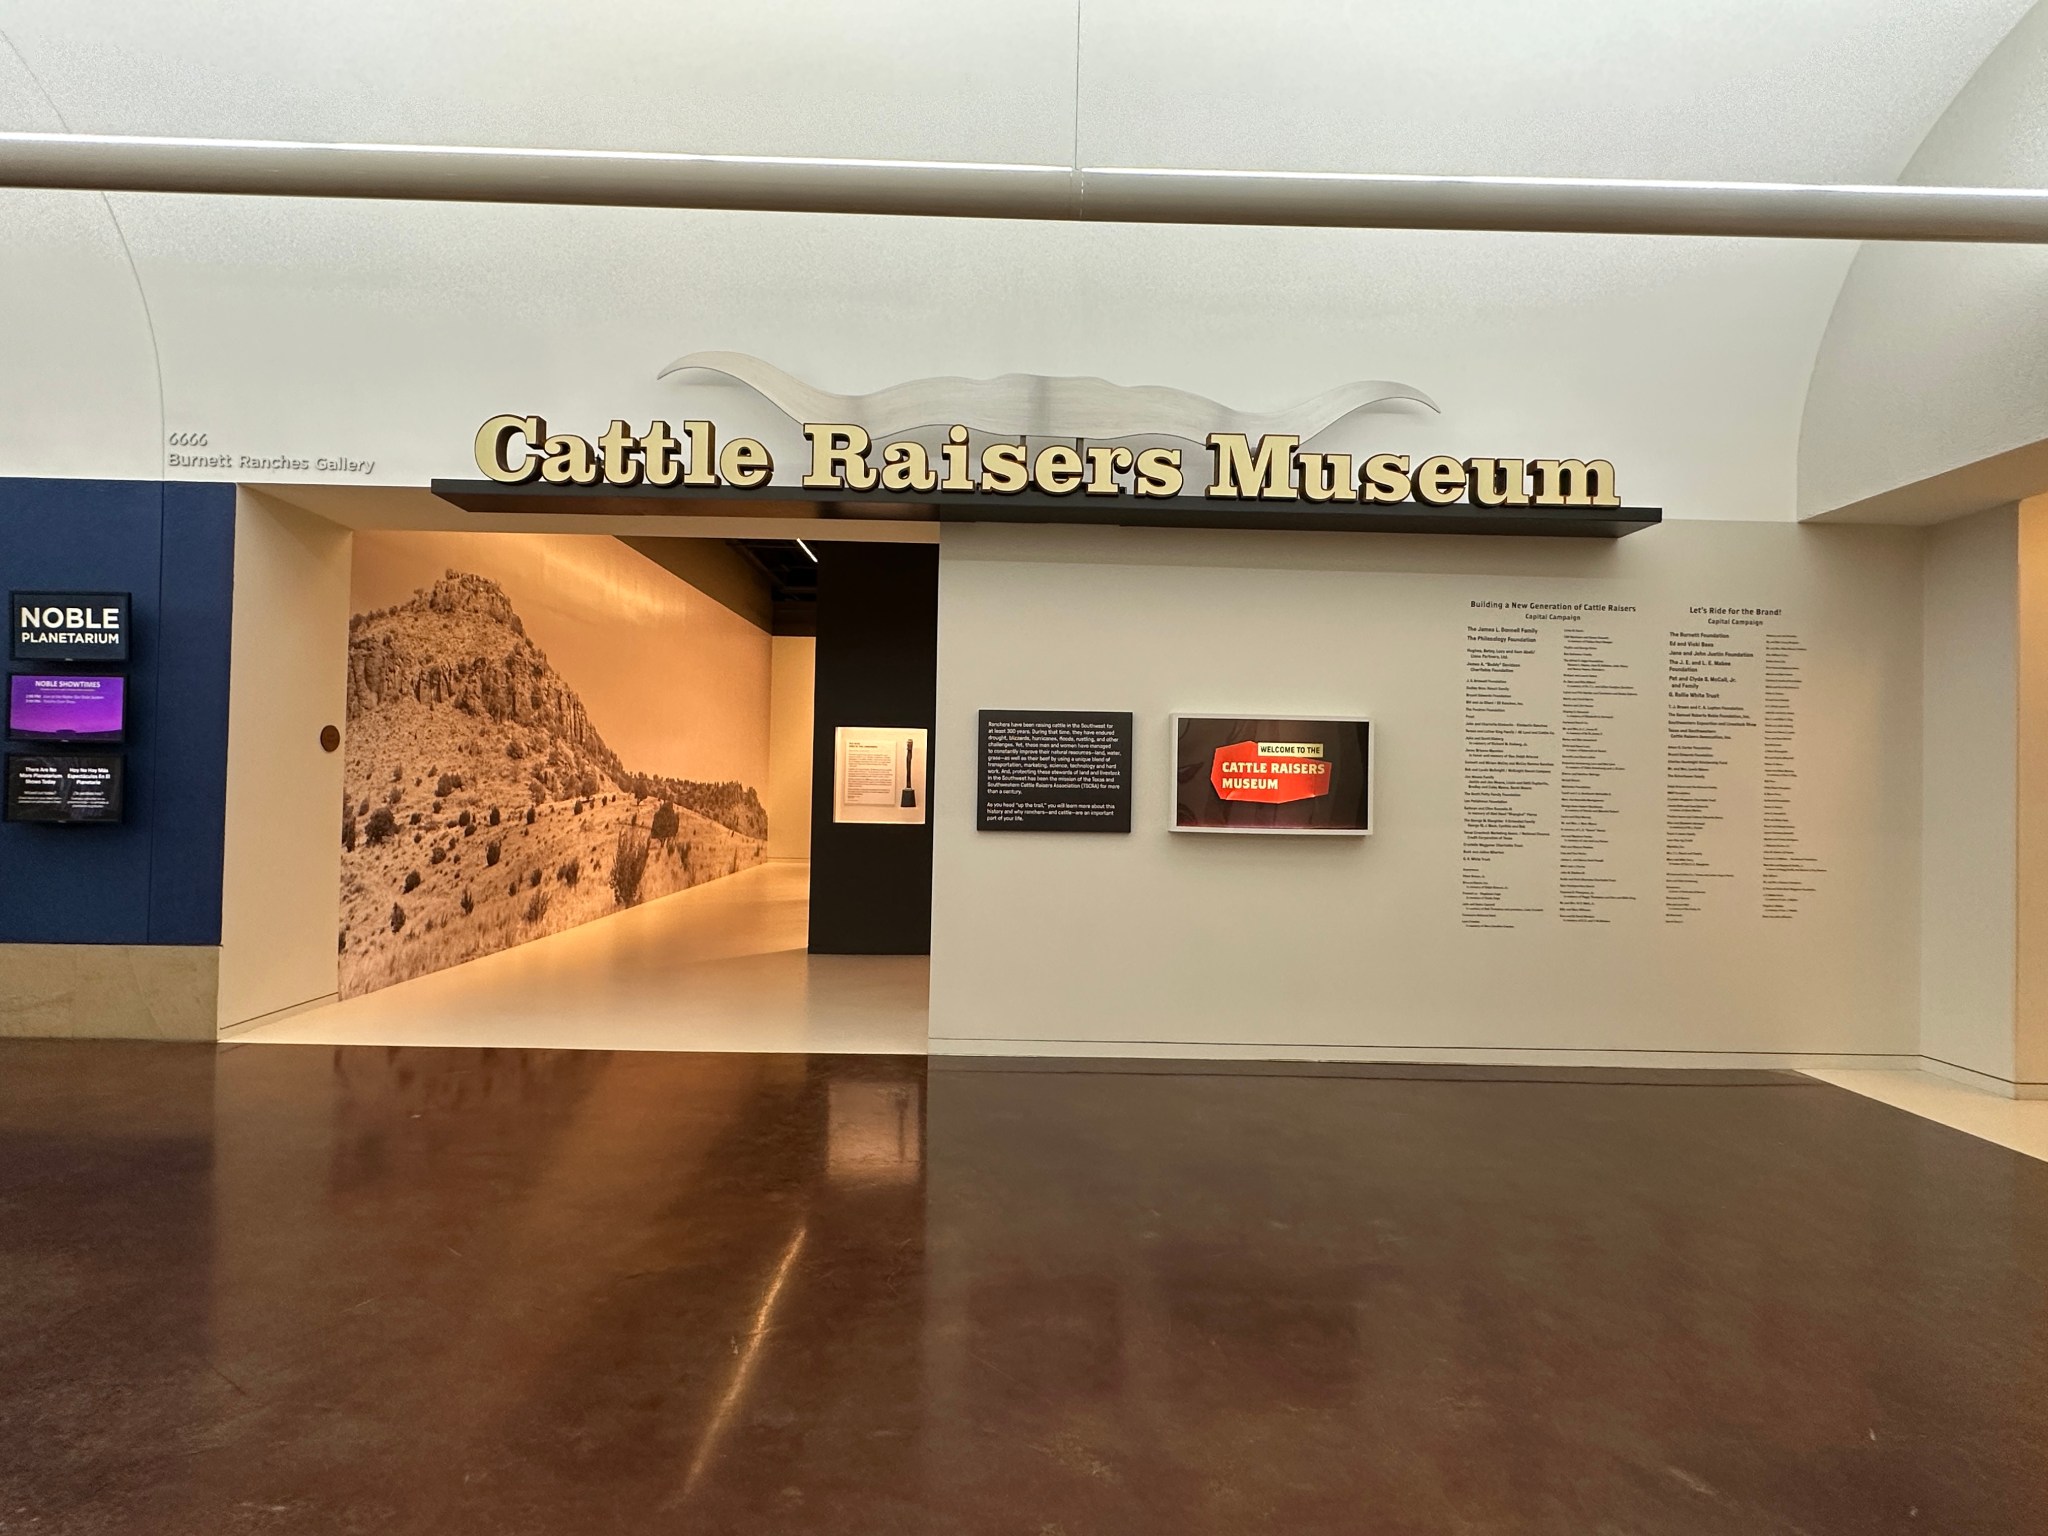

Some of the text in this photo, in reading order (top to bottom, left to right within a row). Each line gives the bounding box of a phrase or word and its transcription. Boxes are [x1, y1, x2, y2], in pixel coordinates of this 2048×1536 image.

[169, 432, 208, 446] 6666
[168, 453, 375, 474] Burnett Ranches Gallery
[473, 413, 1622, 509] Cattle Raisers Museum
[1470, 601, 1502, 609] Building
[20, 606, 120, 629] NOBLE
[21, 632, 120, 644] PLANETARIUM
[1222, 762, 1325, 774] CATTLE RAISERS
[1222, 778, 1278, 790] MUSEUM
